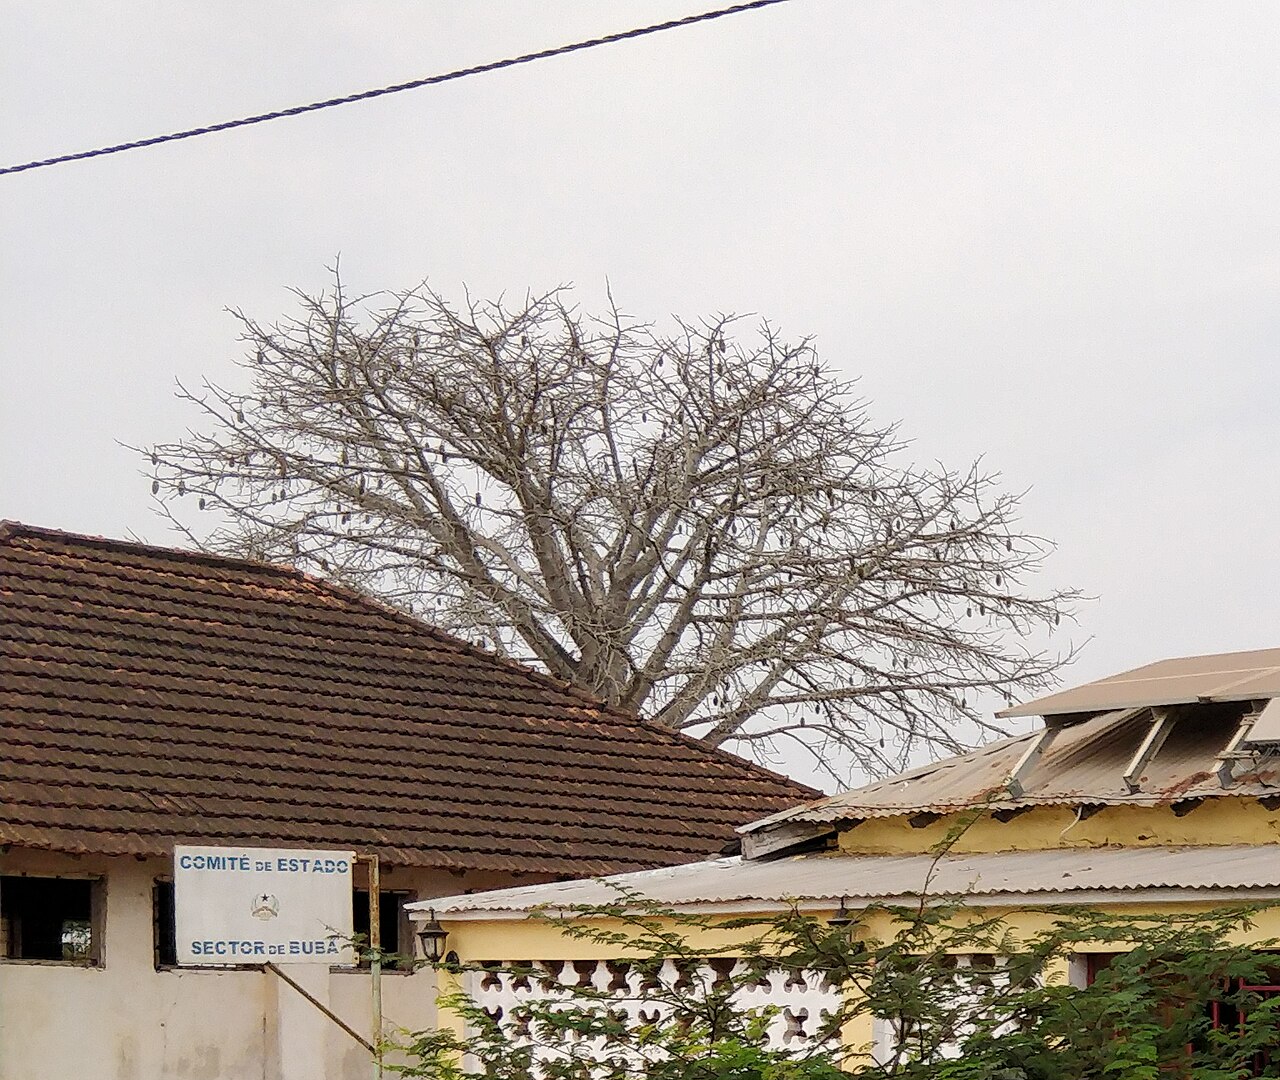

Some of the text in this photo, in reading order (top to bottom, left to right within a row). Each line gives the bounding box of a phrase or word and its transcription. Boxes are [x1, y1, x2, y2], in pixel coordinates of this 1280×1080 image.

[180, 854, 348, 874] COMITÉ DE ESTADO
[191, 940, 265, 955] SECTOR
[268, 944, 286, 955] DE
